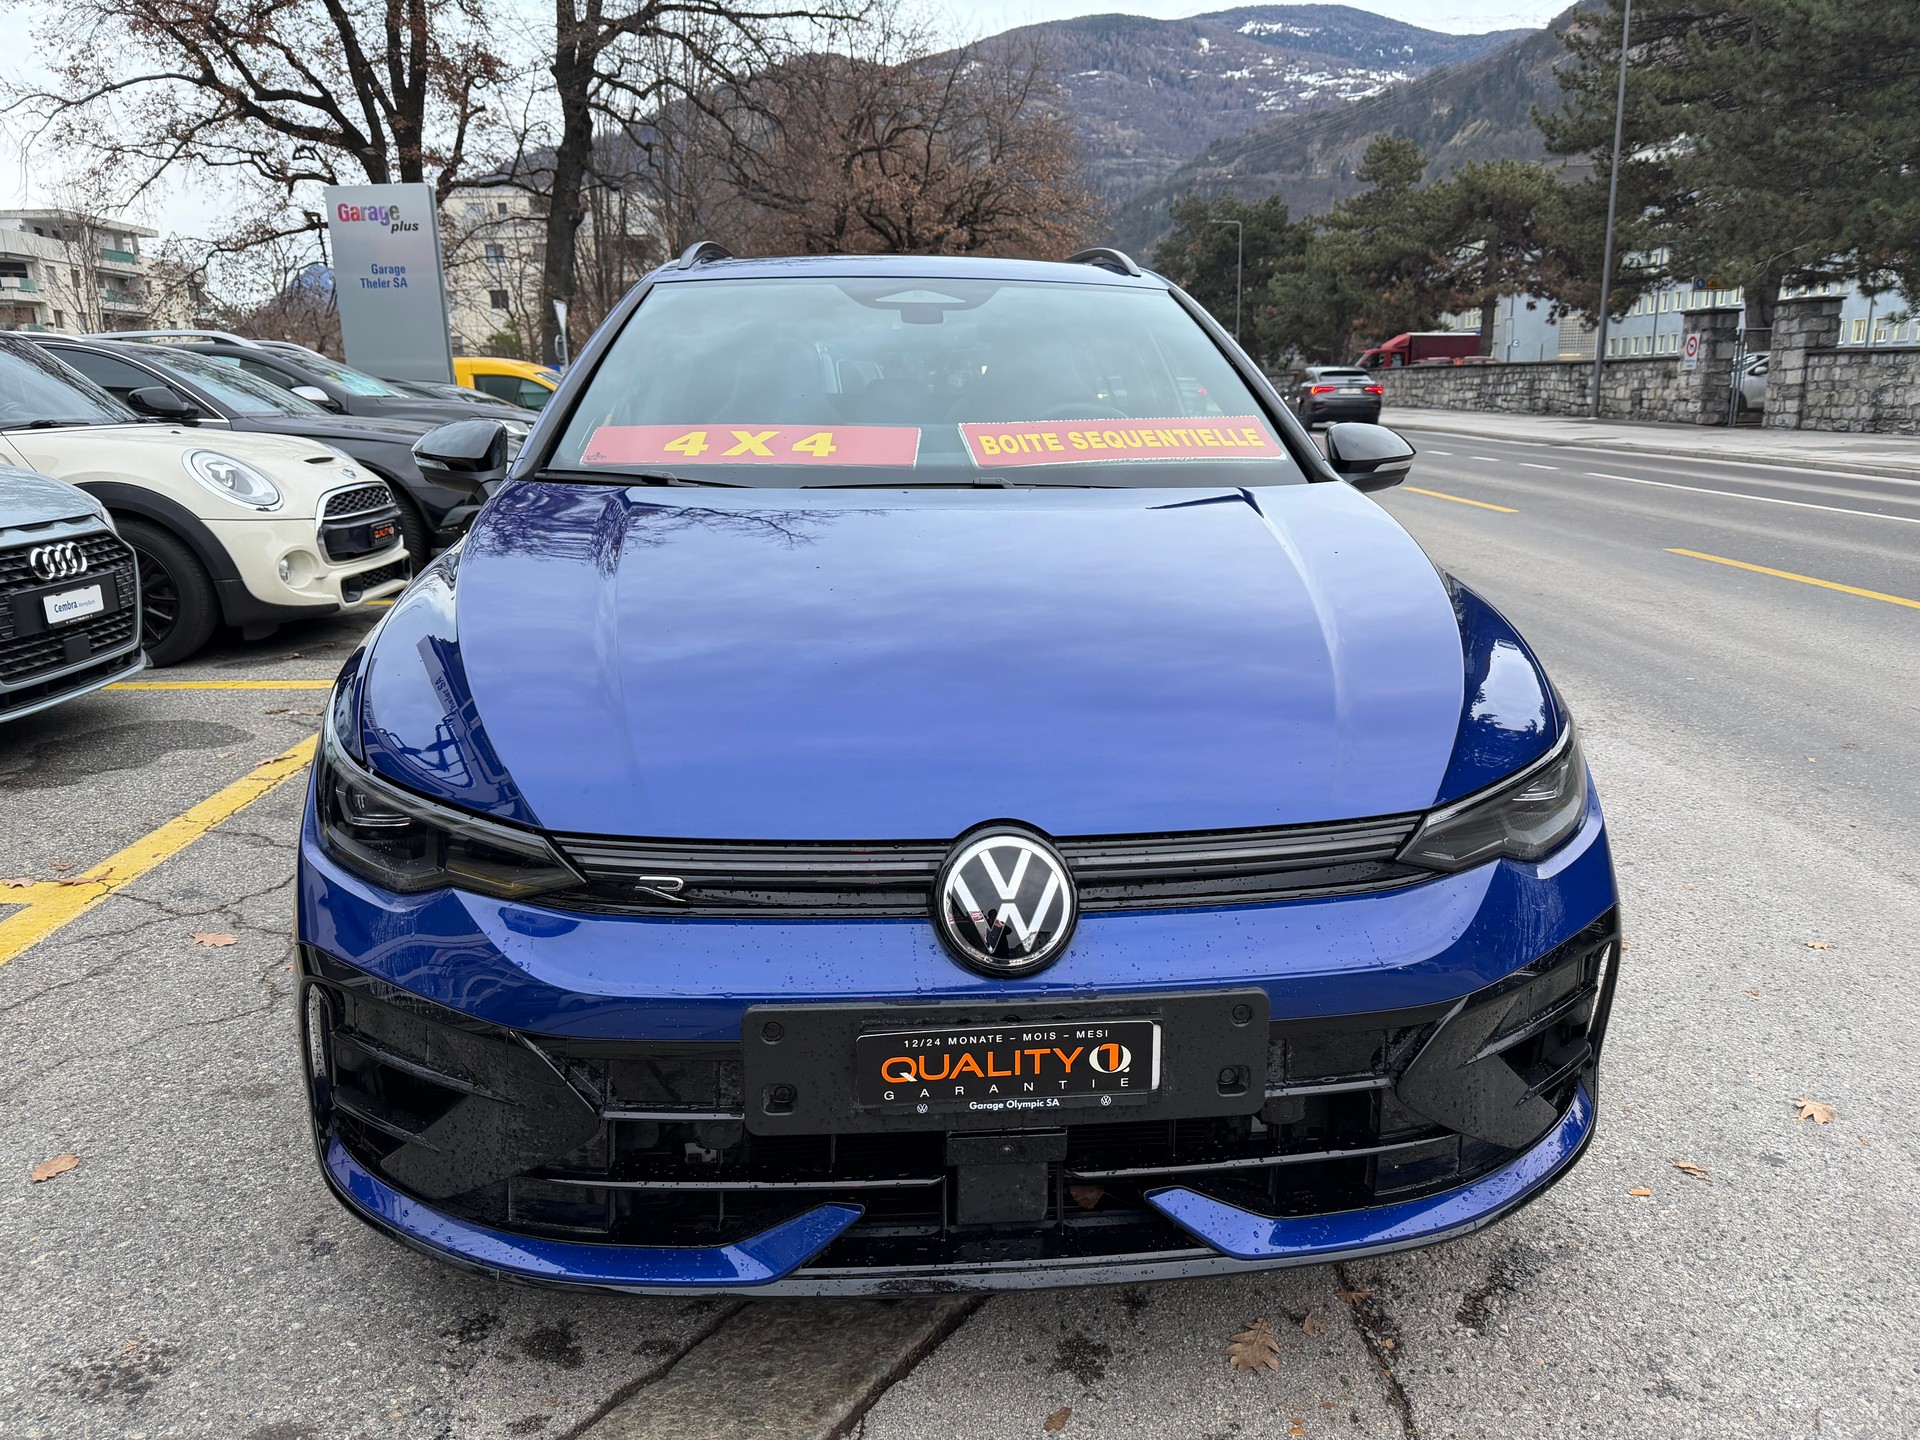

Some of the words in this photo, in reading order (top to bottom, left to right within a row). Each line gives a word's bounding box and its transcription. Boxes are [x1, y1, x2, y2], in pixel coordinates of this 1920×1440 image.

[337, 203, 400, 226] Garage
[391, 220, 419, 234] plus
[371, 263, 406, 276] Garage
[360, 277, 391, 289] Theler
[393, 277, 408, 288] SA
[978, 432, 1065, 455] BOITE
[1071, 428, 1266, 449] SEQUENTIELLE
[53, 600, 78, 613] Cembra
[904, 1038, 941, 1048] 12/24
[948, 1035, 1003, 1045] MONATE
[1023, 1032, 1057, 1041] MOIS
[1076, 1030, 1108, 1039] MESI
[881, 1046, 1084, 1084] QUALITY
[883, 1077, 1129, 1101] GARANTIE
[969, 1101, 1004, 1111] Garage
[1006, 1099, 1045, 1110] Olympic
[1046, 1098, 1060, 1108] SA
